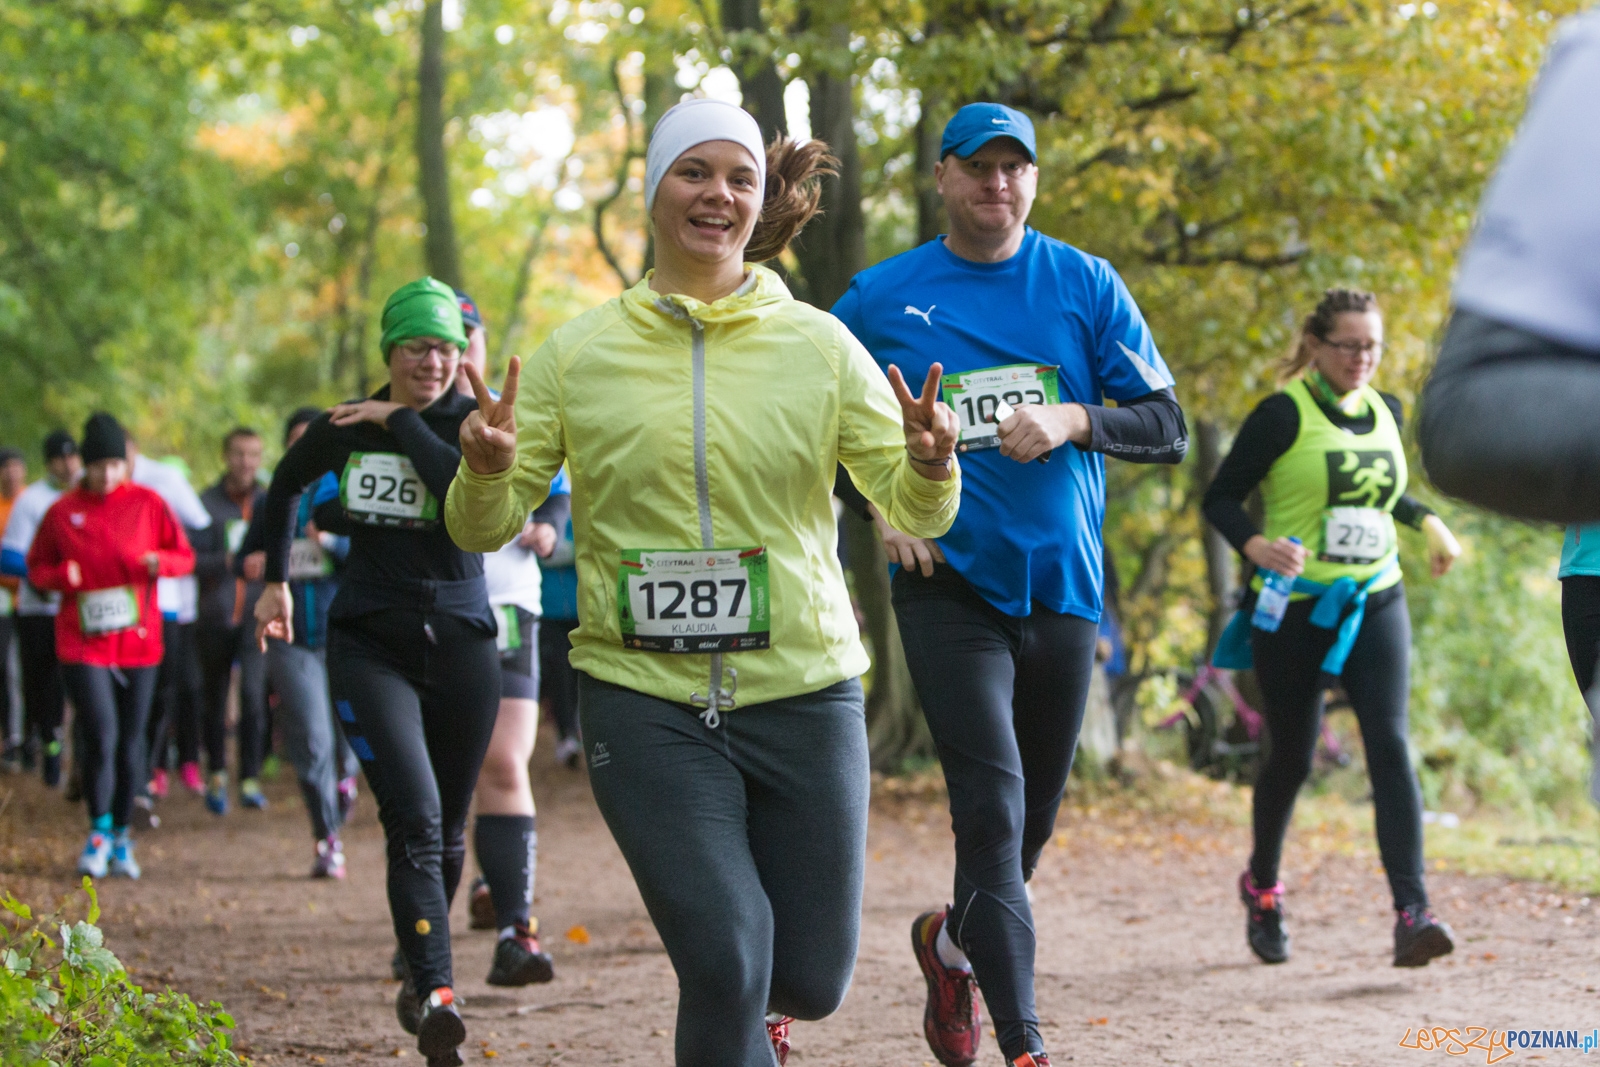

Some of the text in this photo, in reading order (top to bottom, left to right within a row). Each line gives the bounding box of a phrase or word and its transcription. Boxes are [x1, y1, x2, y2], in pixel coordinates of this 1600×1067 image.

[358, 473, 418, 505] 926
[1337, 523, 1379, 548] 279
[639, 578, 747, 620] 1287
[672, 623, 718, 634] KLAUDIA
